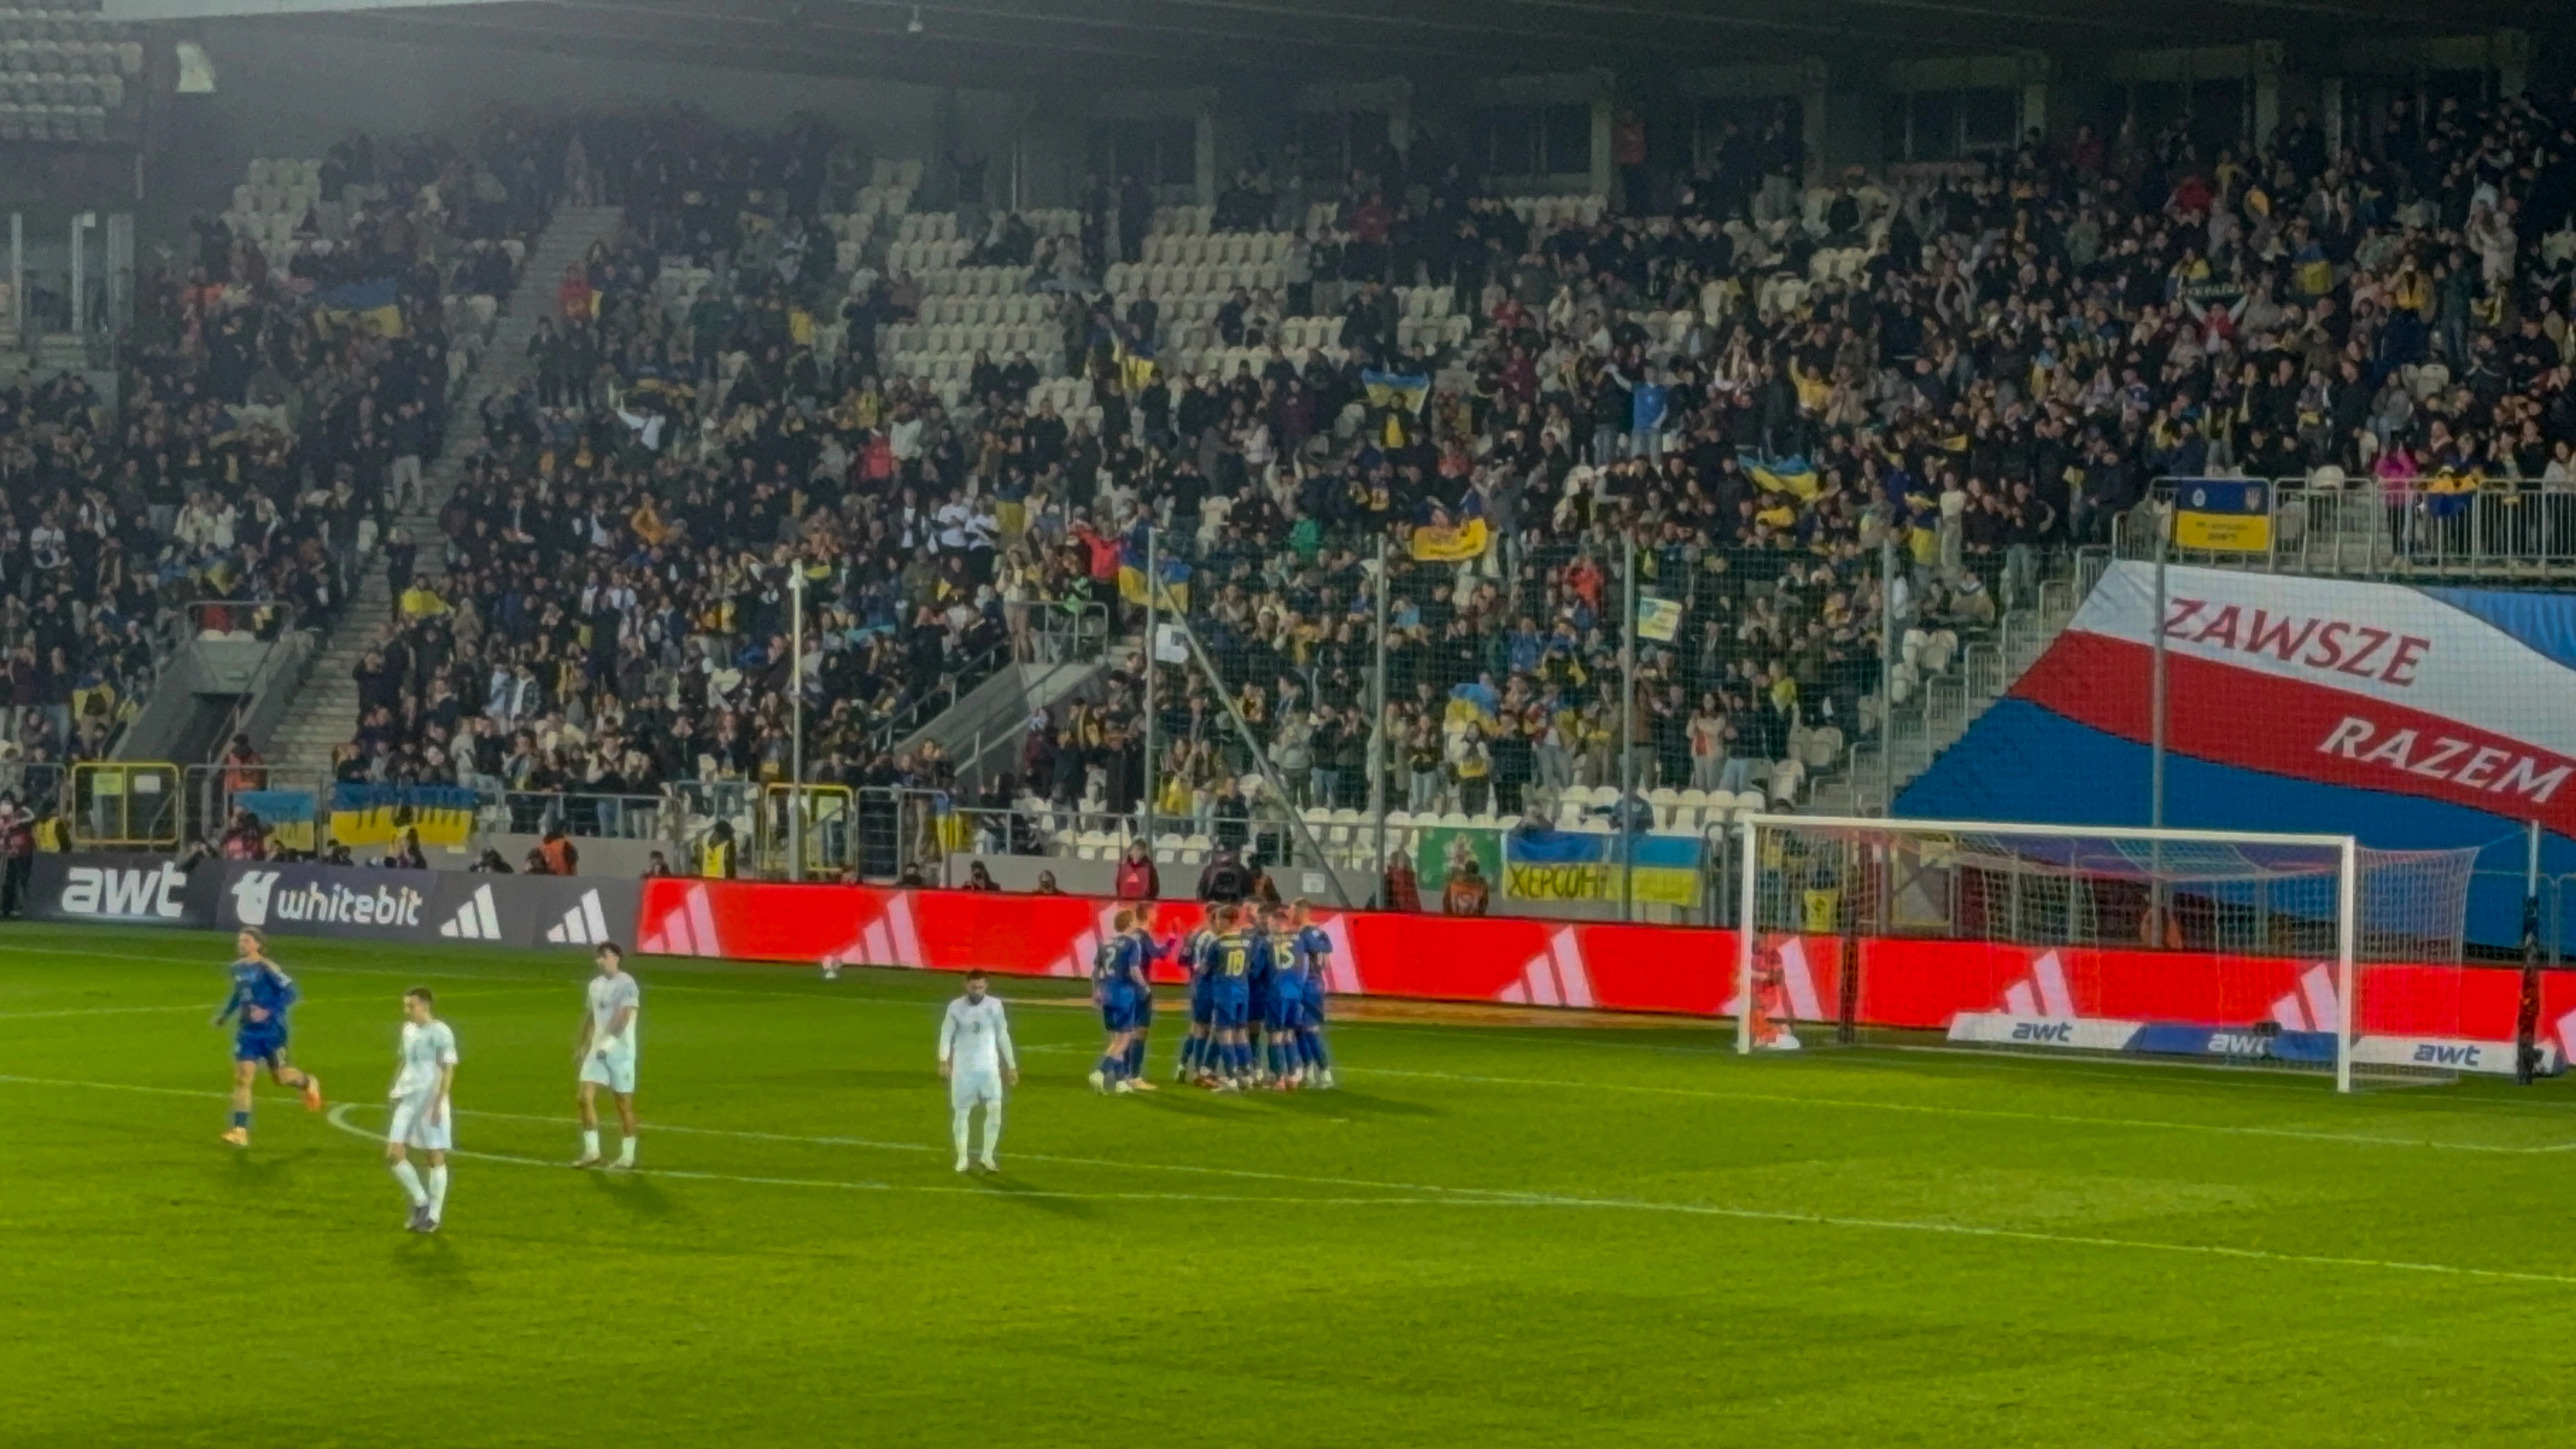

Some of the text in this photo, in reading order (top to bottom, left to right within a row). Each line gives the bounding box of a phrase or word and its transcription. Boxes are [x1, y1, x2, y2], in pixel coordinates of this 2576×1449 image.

[2163, 596, 2431, 686] ZAWSZE
[2317, 716, 2574, 803] RAZEM
[61, 861, 187, 918] awt
[1508, 864, 1598, 899] ХЕРСОН
[277, 882, 423, 926] whitebit
[1273, 941, 1295, 970] 15
[2012, 1021, 2073, 1043] awt
[2414, 1042, 2481, 1067] awt
